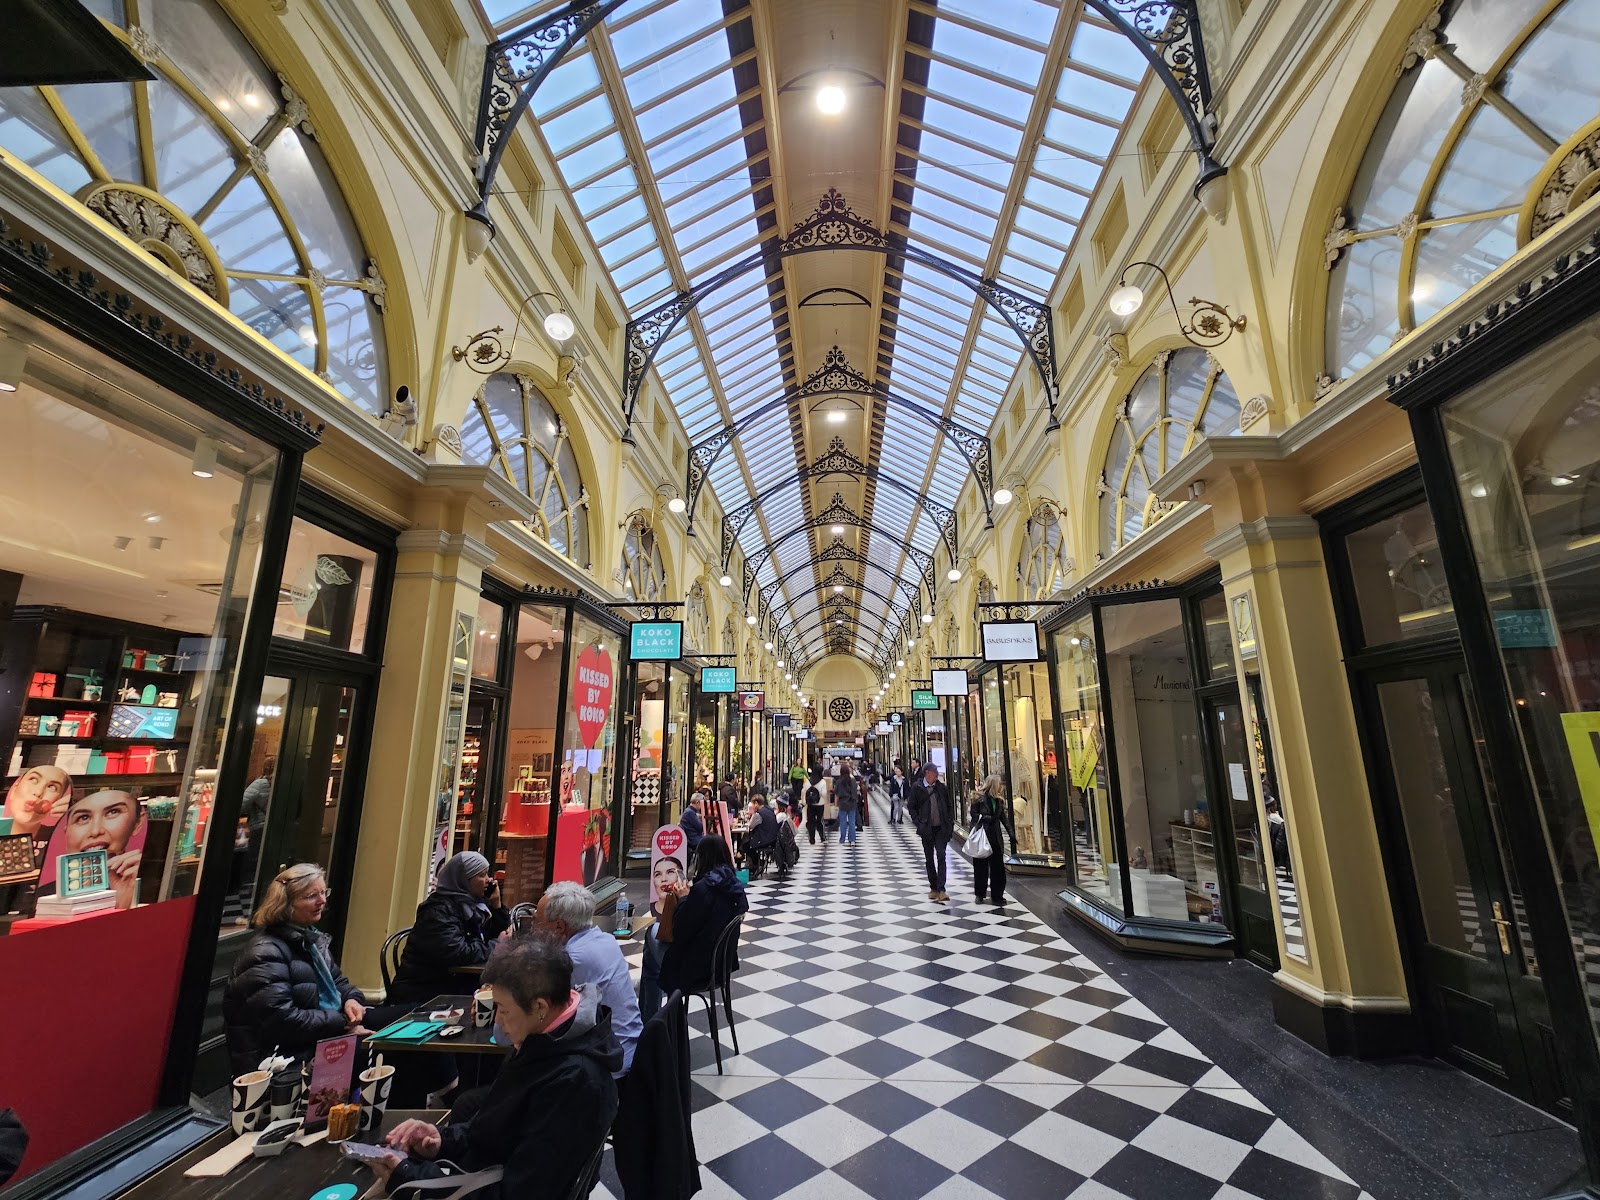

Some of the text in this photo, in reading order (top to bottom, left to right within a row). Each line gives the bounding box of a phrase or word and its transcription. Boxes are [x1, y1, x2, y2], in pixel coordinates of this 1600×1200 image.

[636, 638, 674, 646] BLACK
[579, 666, 609, 688] KISSED
[587, 688, 600, 703] BY
[256, 704, 283, 717] ACK
[579, 705, 605, 723] KOKO
